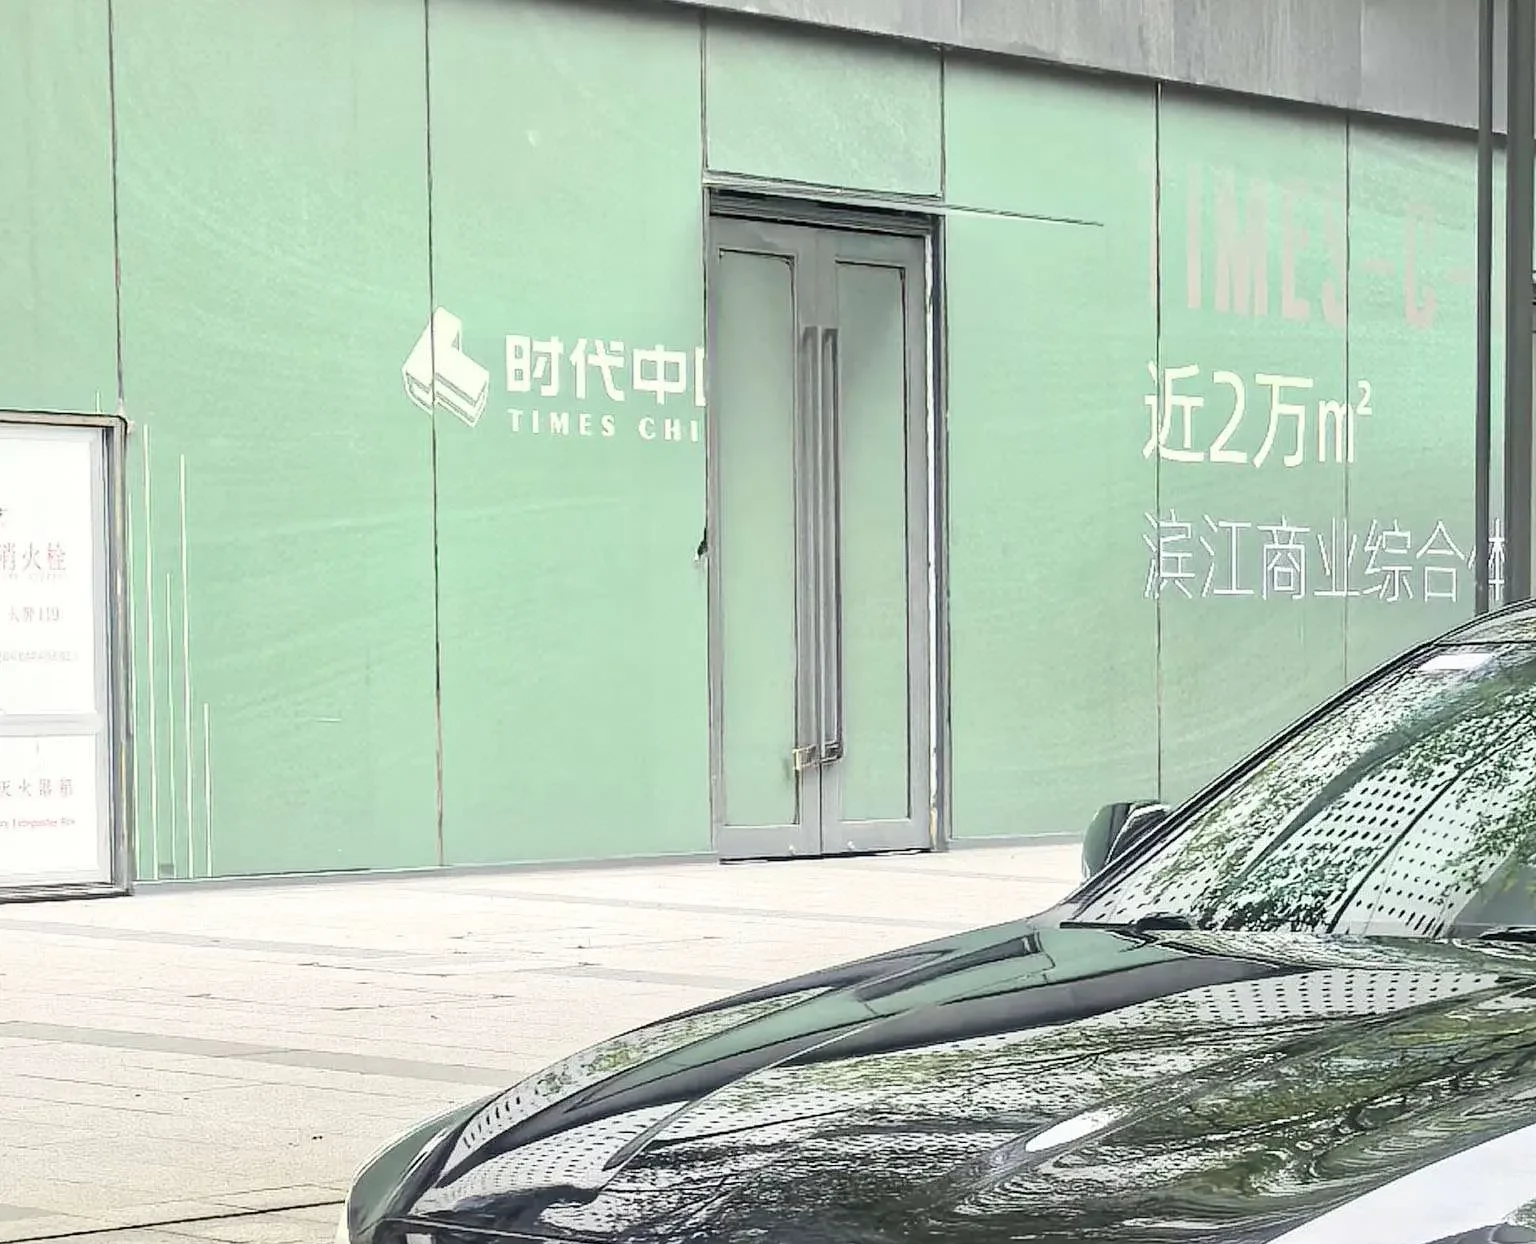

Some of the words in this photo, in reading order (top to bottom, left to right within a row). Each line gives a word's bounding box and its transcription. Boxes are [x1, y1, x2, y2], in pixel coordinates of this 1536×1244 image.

[505, 334, 706, 407] 时代中
[507, 408, 616, 437] TIMES
